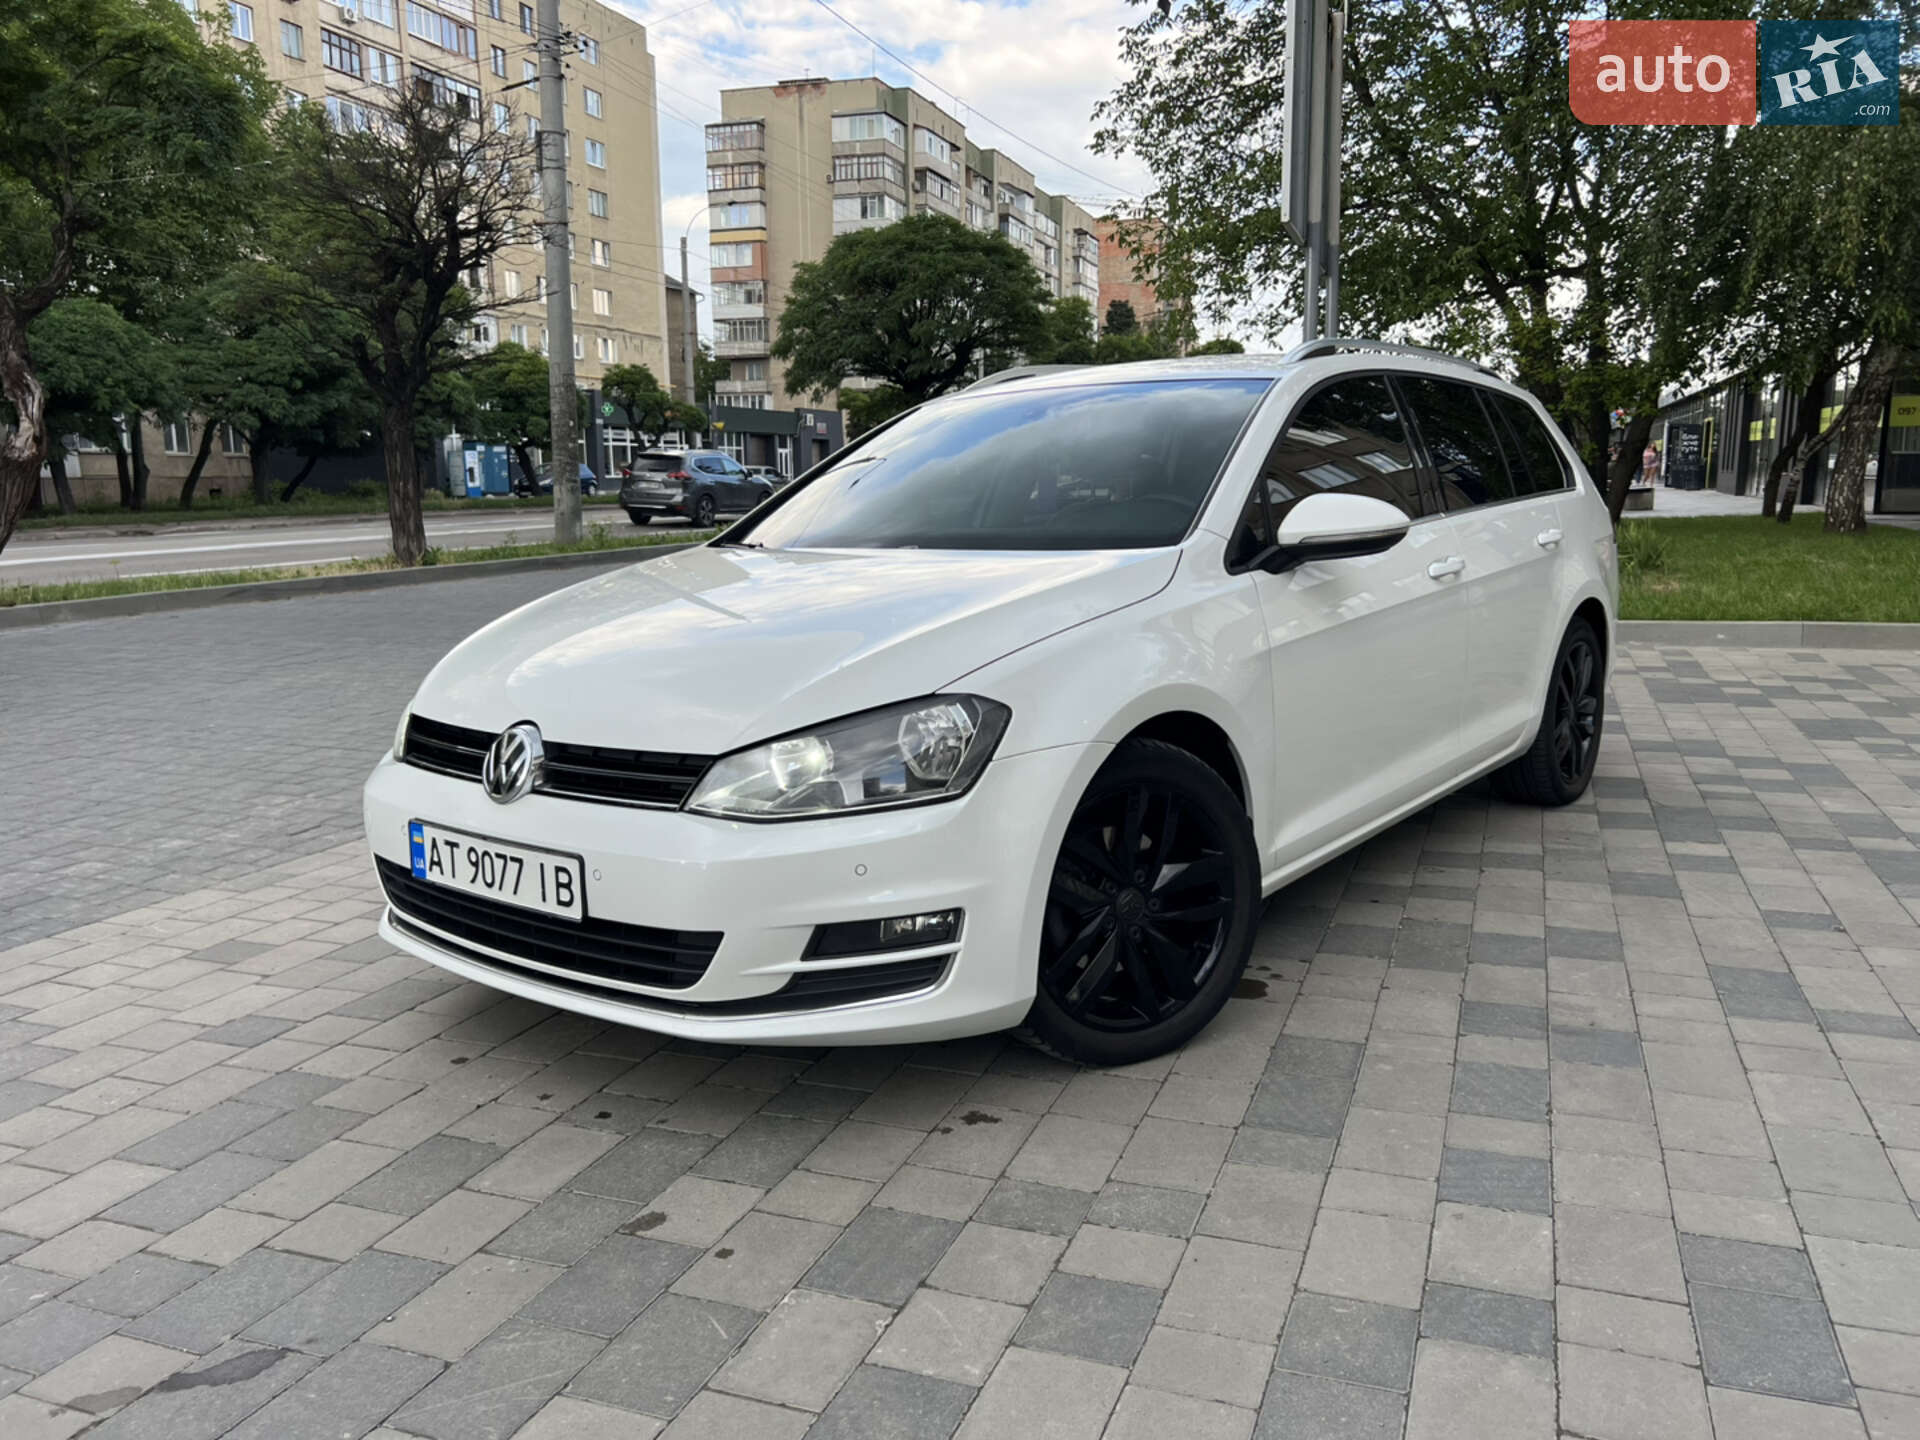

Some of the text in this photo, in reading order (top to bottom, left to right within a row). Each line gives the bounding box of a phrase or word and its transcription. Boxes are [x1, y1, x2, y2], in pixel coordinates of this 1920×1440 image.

[414, 857, 426, 869] UA
[428, 837, 575, 909] AT 9077 IB
